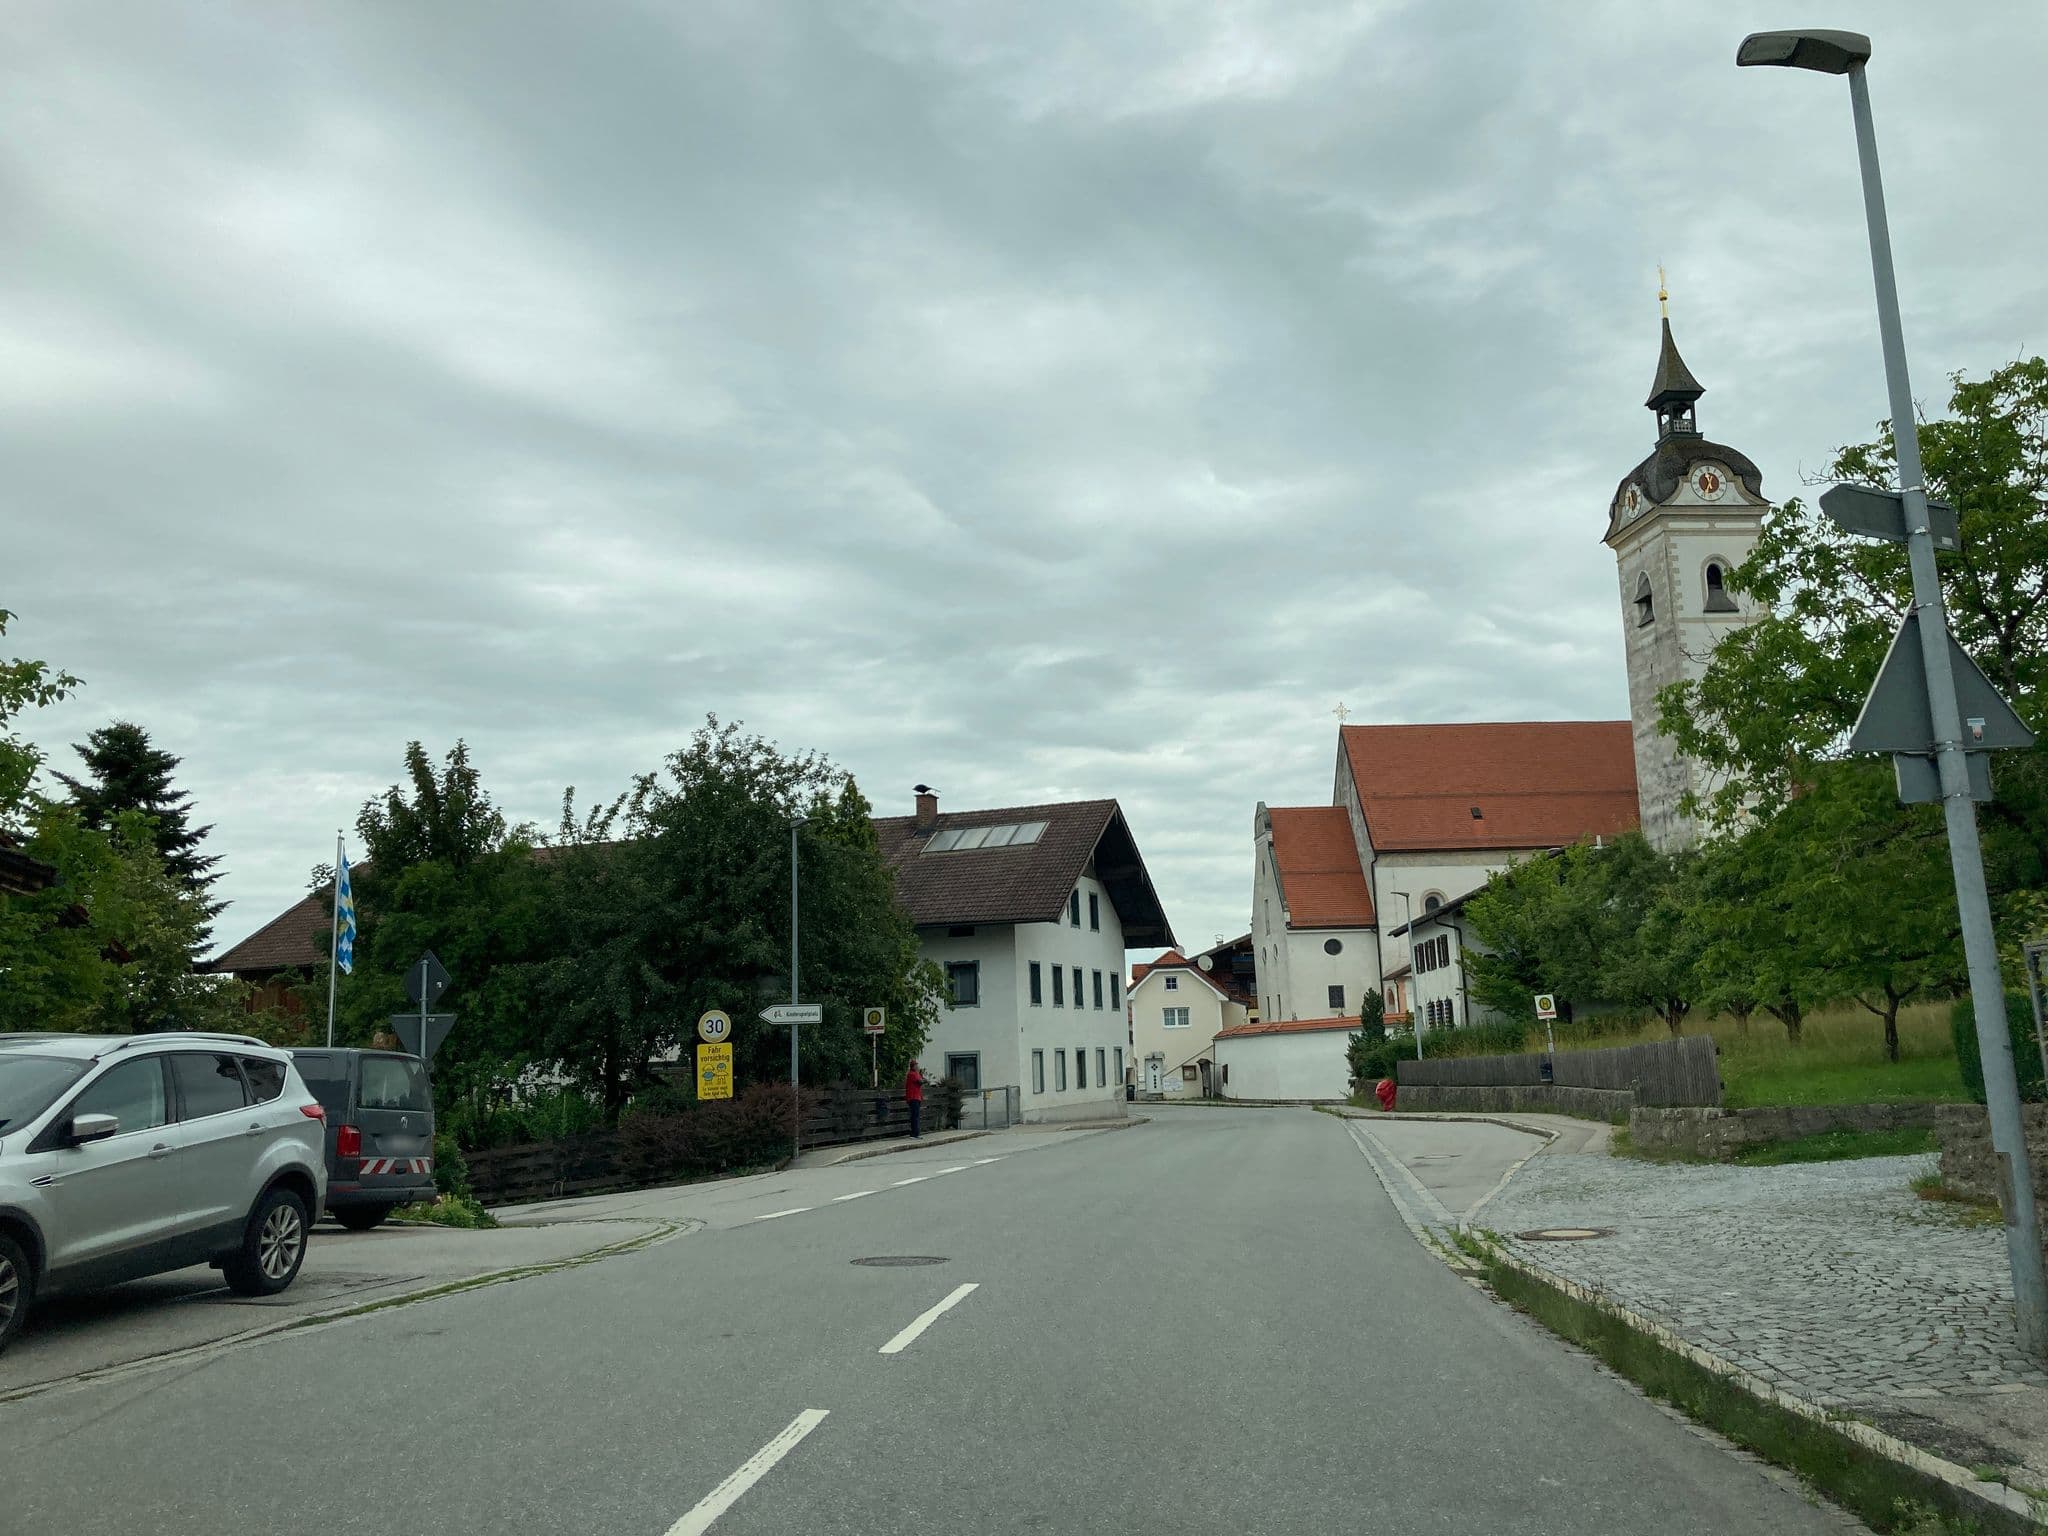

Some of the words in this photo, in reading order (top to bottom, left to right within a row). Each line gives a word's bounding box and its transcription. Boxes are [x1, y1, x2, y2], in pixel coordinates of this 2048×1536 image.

[705, 1019, 724, 1034] 30
[708, 1046, 722, 1054] Fahr
[700, 1054, 730, 1063] vorsichtig
